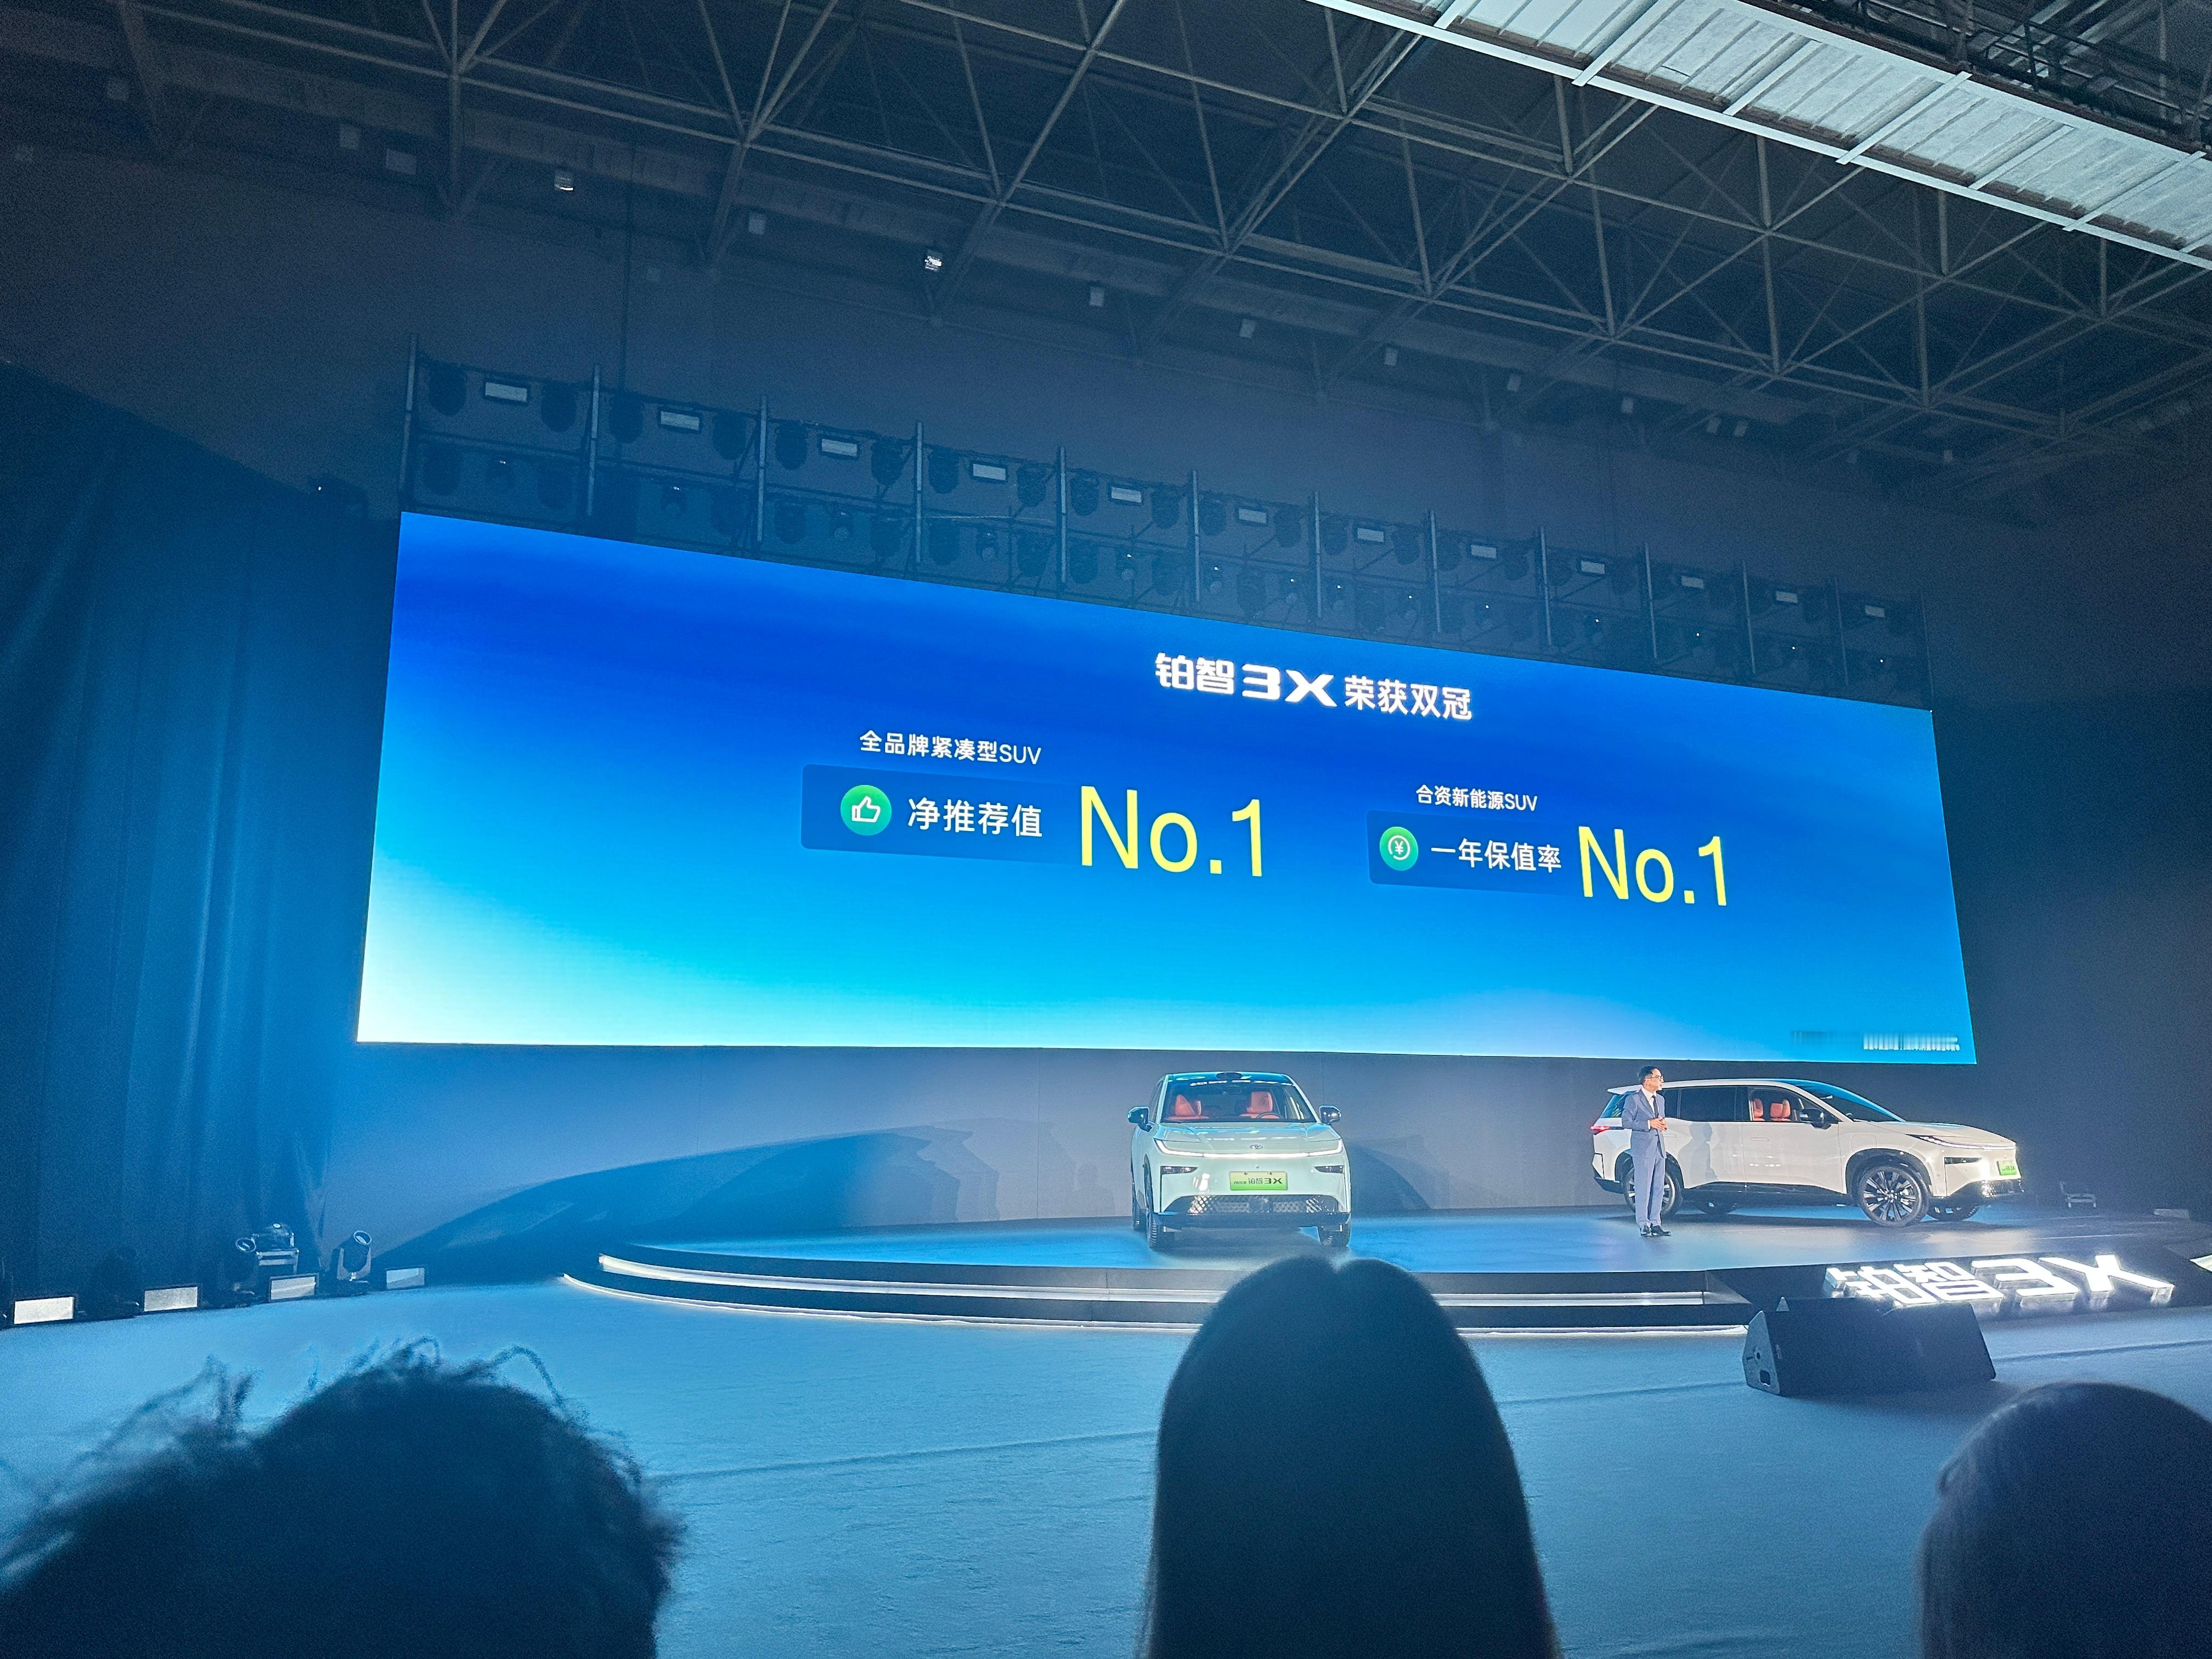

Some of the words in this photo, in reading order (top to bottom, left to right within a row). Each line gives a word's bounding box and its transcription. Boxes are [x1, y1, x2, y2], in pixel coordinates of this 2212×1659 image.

[1344, 675, 1472, 721] 荣获双冠
[860, 730, 1041, 765] 全品牌紧凑型SUV
[908, 797, 1042, 837] 净推荐值
[1415, 785, 1538, 811] 合资新能源SUV
[1081, 786, 1262, 877] No.1
[1431, 838, 1562, 873] 一年保值率
[1578, 826, 1726, 906] No.1
[1825, 1254, 2174, 1307] 铂智3X
